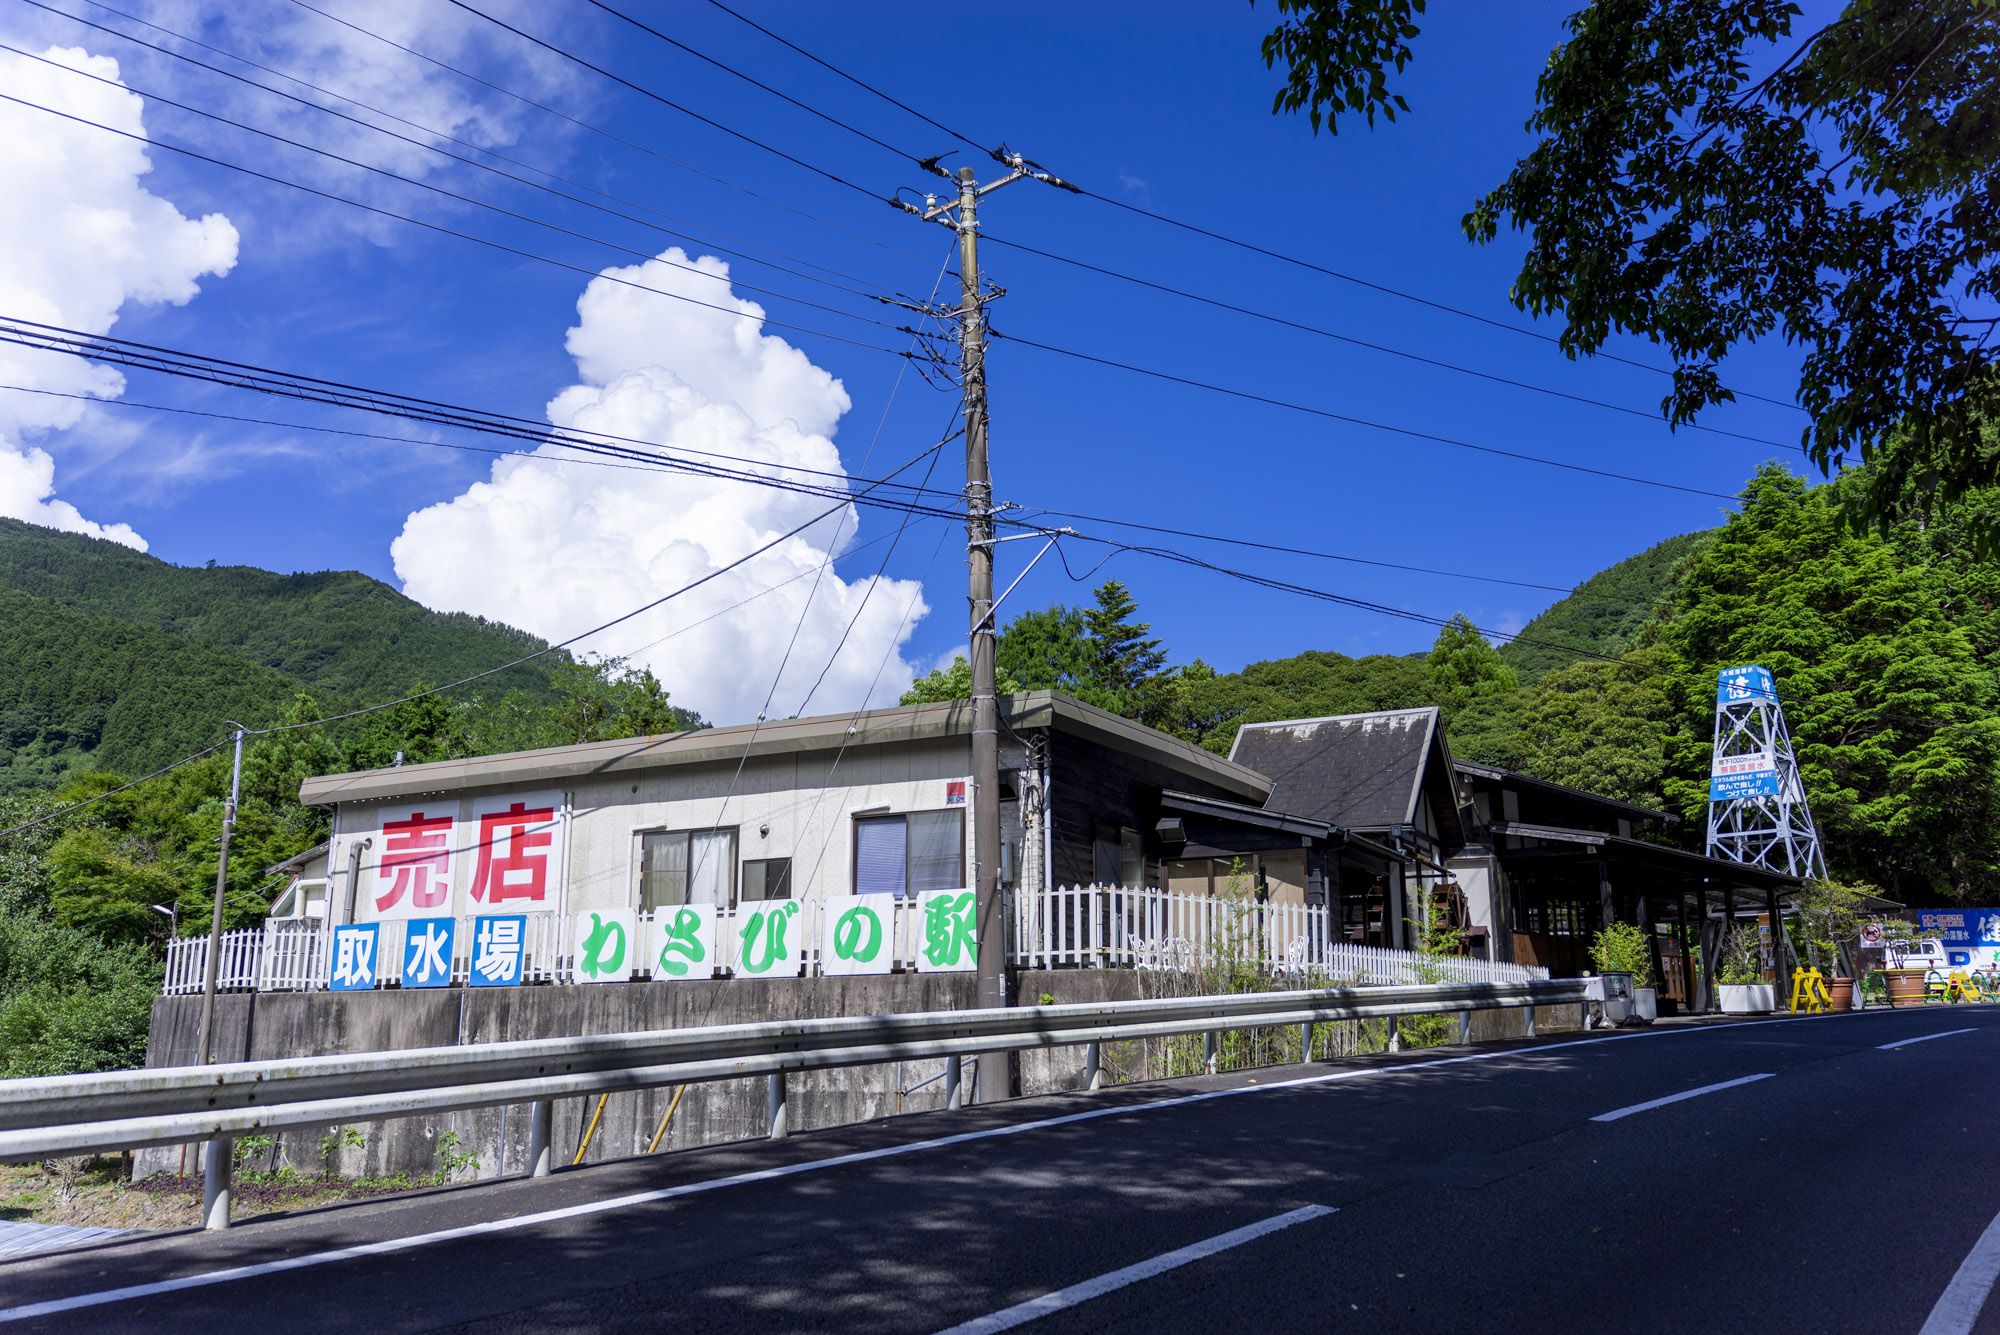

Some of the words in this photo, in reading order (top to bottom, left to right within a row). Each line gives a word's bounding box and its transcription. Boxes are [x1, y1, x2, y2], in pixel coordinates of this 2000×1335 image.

[375, 802, 554, 912] 売店
[333, 919, 520, 987] 取水場
[580, 892, 977, 979] わさびの駅
[1948, 951, 1971, 966] P
